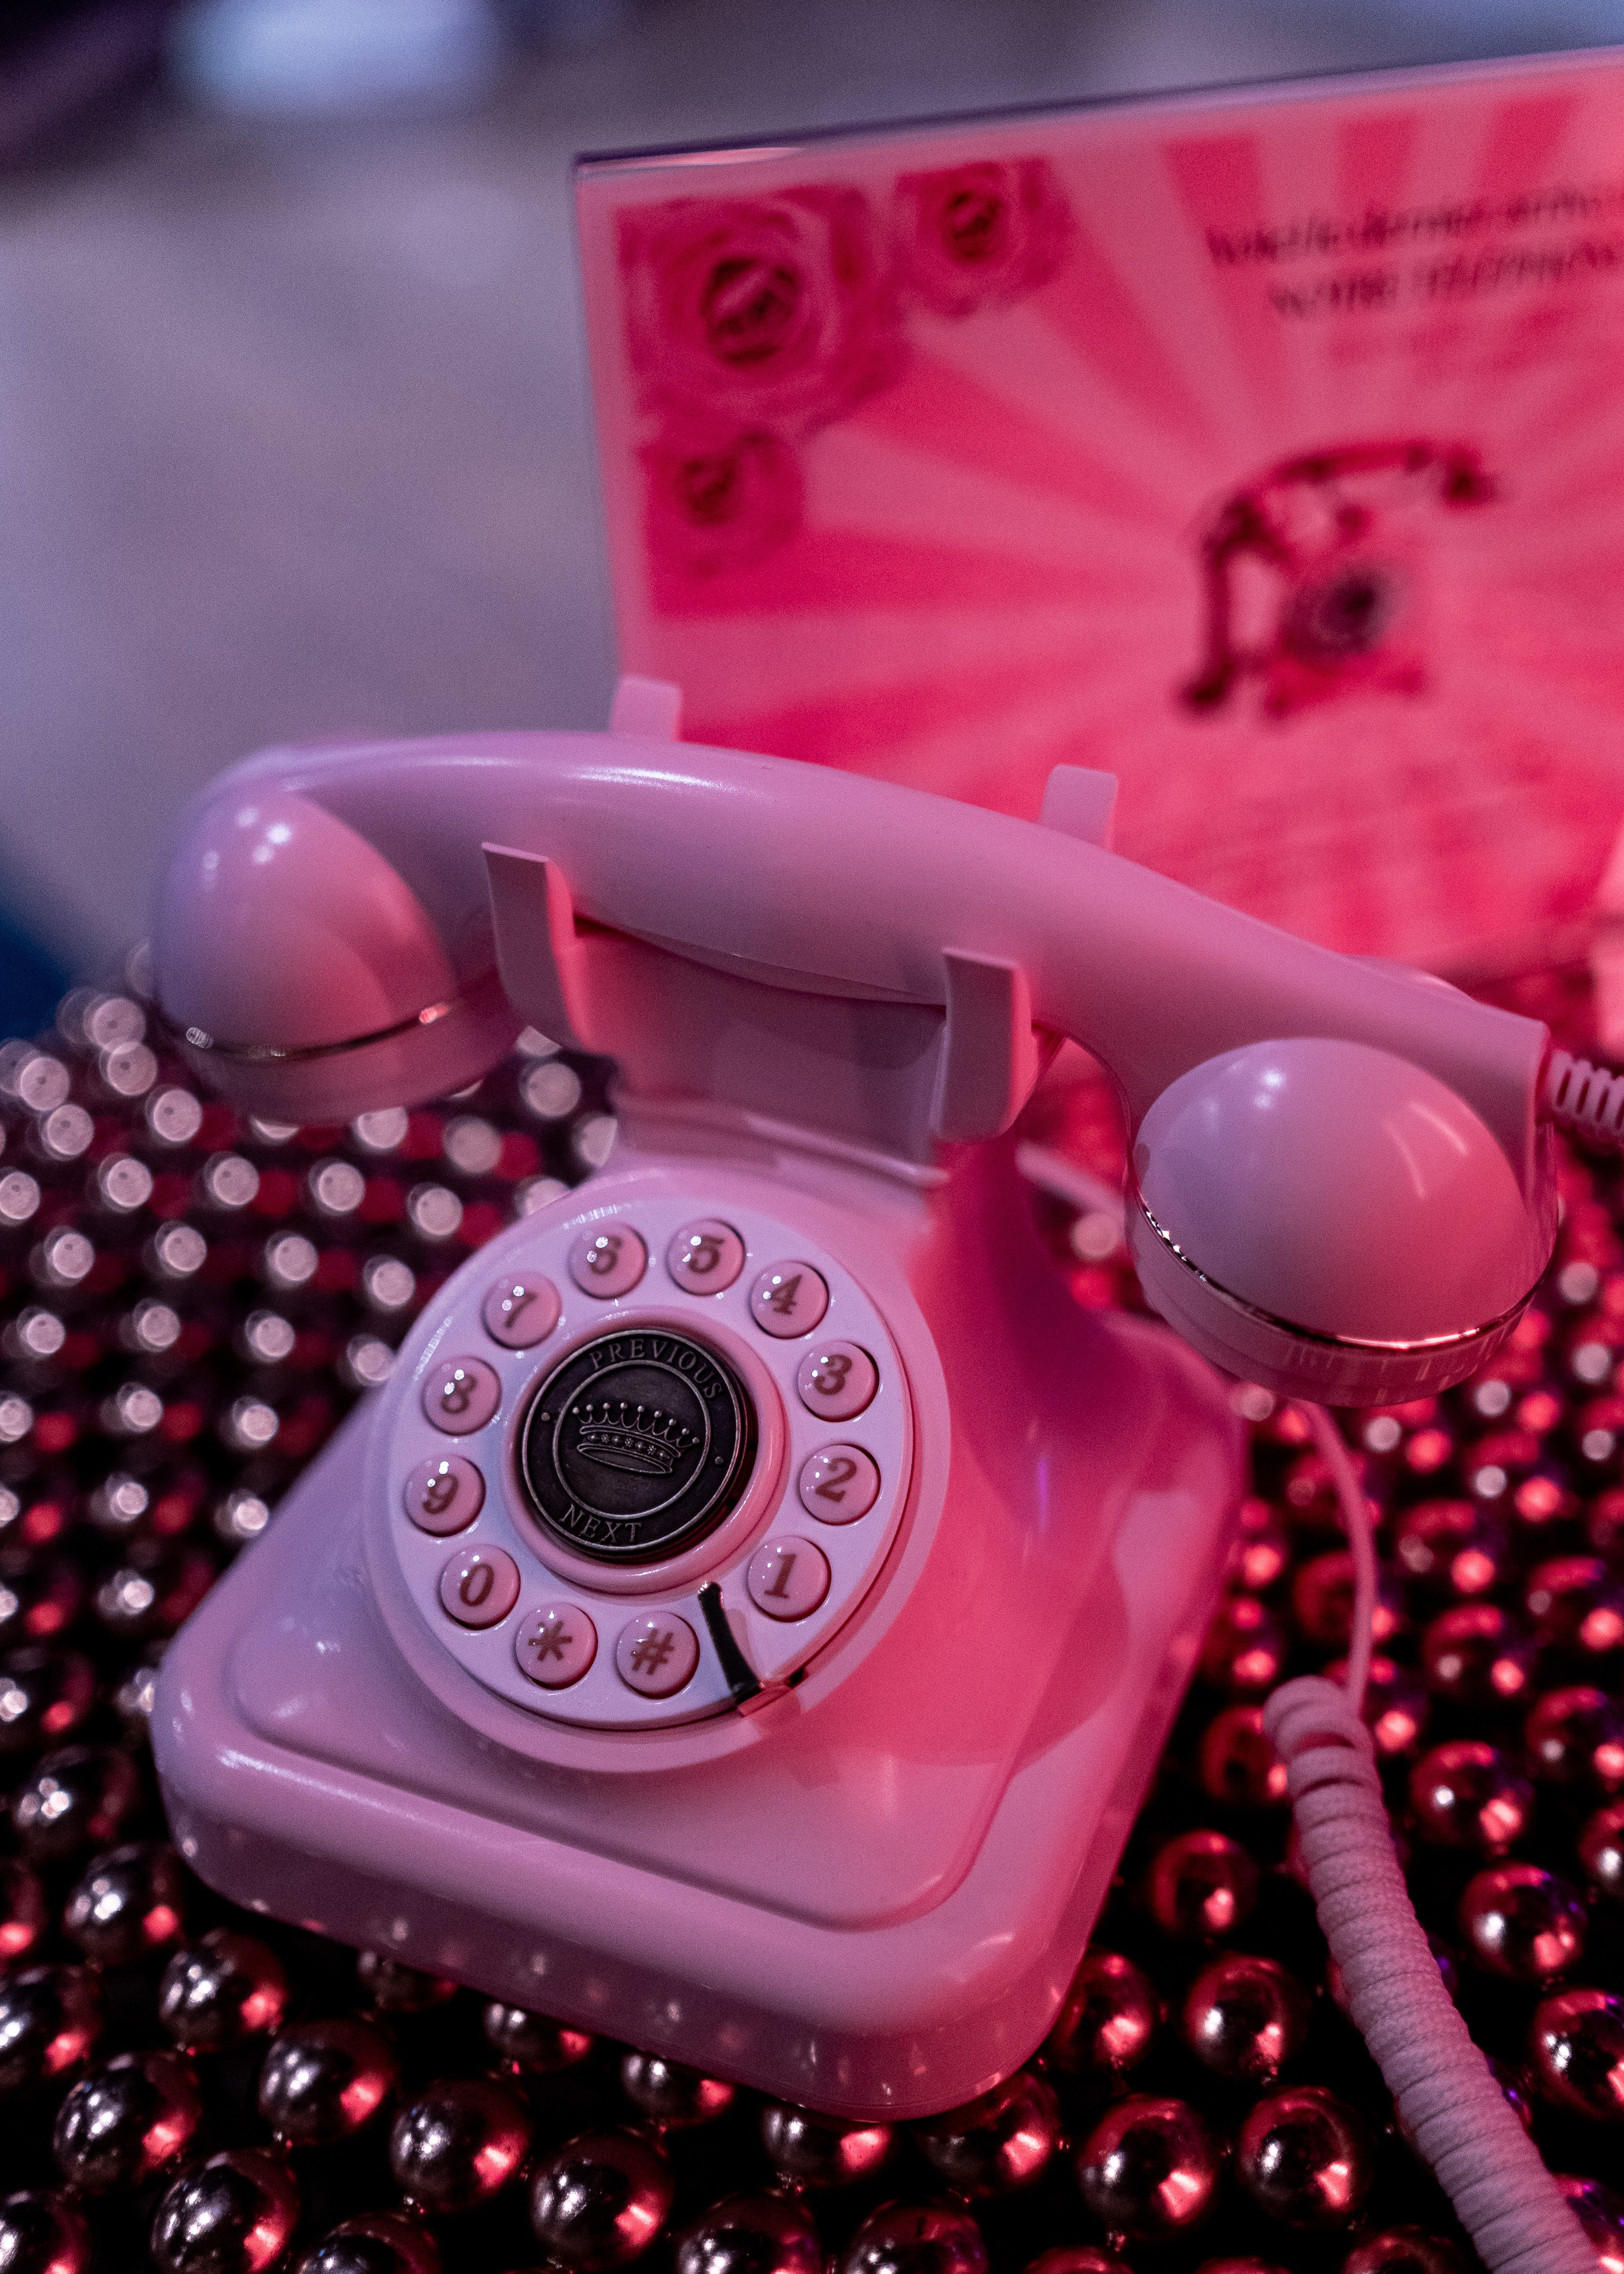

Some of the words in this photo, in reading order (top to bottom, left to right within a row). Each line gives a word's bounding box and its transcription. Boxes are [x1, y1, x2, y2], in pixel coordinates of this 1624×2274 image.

[591, 1235, 622, 1275] 6
[688, 1235, 724, 1275] 5
[504, 1289, 538, 1330] 7
[769, 1274, 802, 1315] 4
[589, 1338, 723, 1398] PREVIOUS
[814, 1354, 853, 1395] 3
[441, 1374, 478, 1414] 8
[422, 1473, 459, 1515] 9
[815, 1457, 857, 1502] 2
[559, 1504, 642, 1543] NEXT
[460, 1563, 495, 1607] 0
[764, 1553, 797, 1599] 1
[631, 1628, 675, 1675] #
